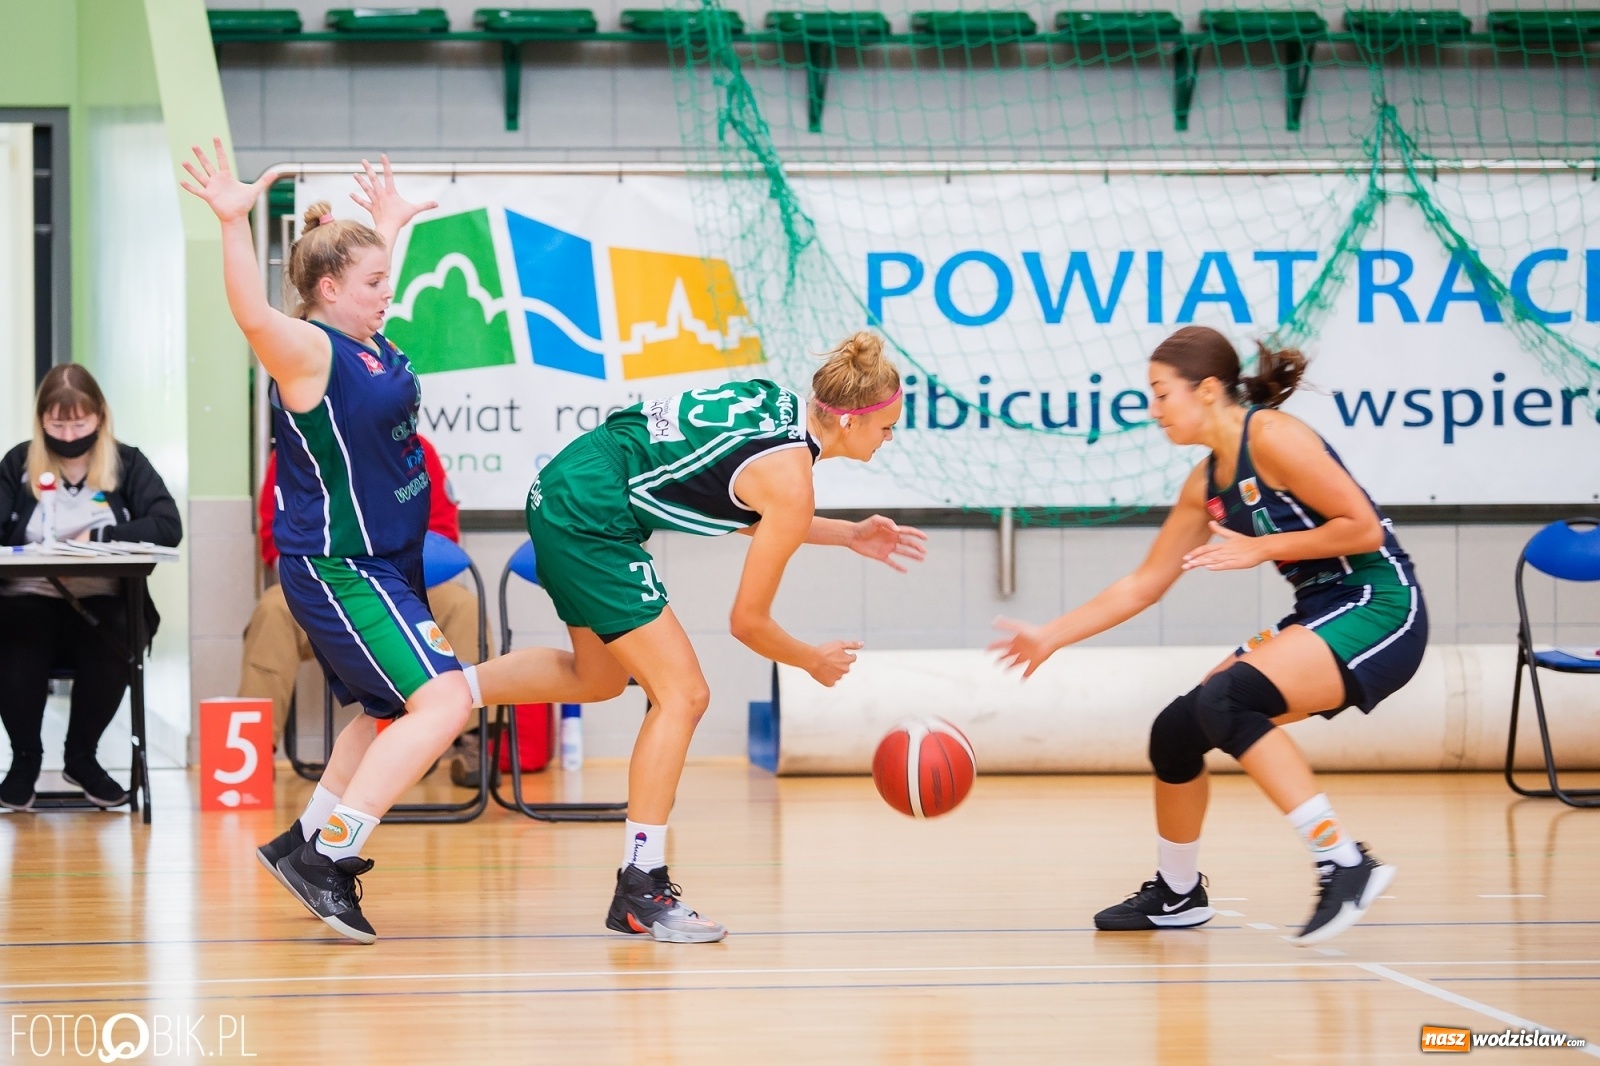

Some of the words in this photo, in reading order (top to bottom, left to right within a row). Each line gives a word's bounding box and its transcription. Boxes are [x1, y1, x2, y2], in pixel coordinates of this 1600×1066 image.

[866, 250, 1317, 327] POWIAT
[417, 394, 522, 432] wiat
[213, 711, 262, 784] 5
